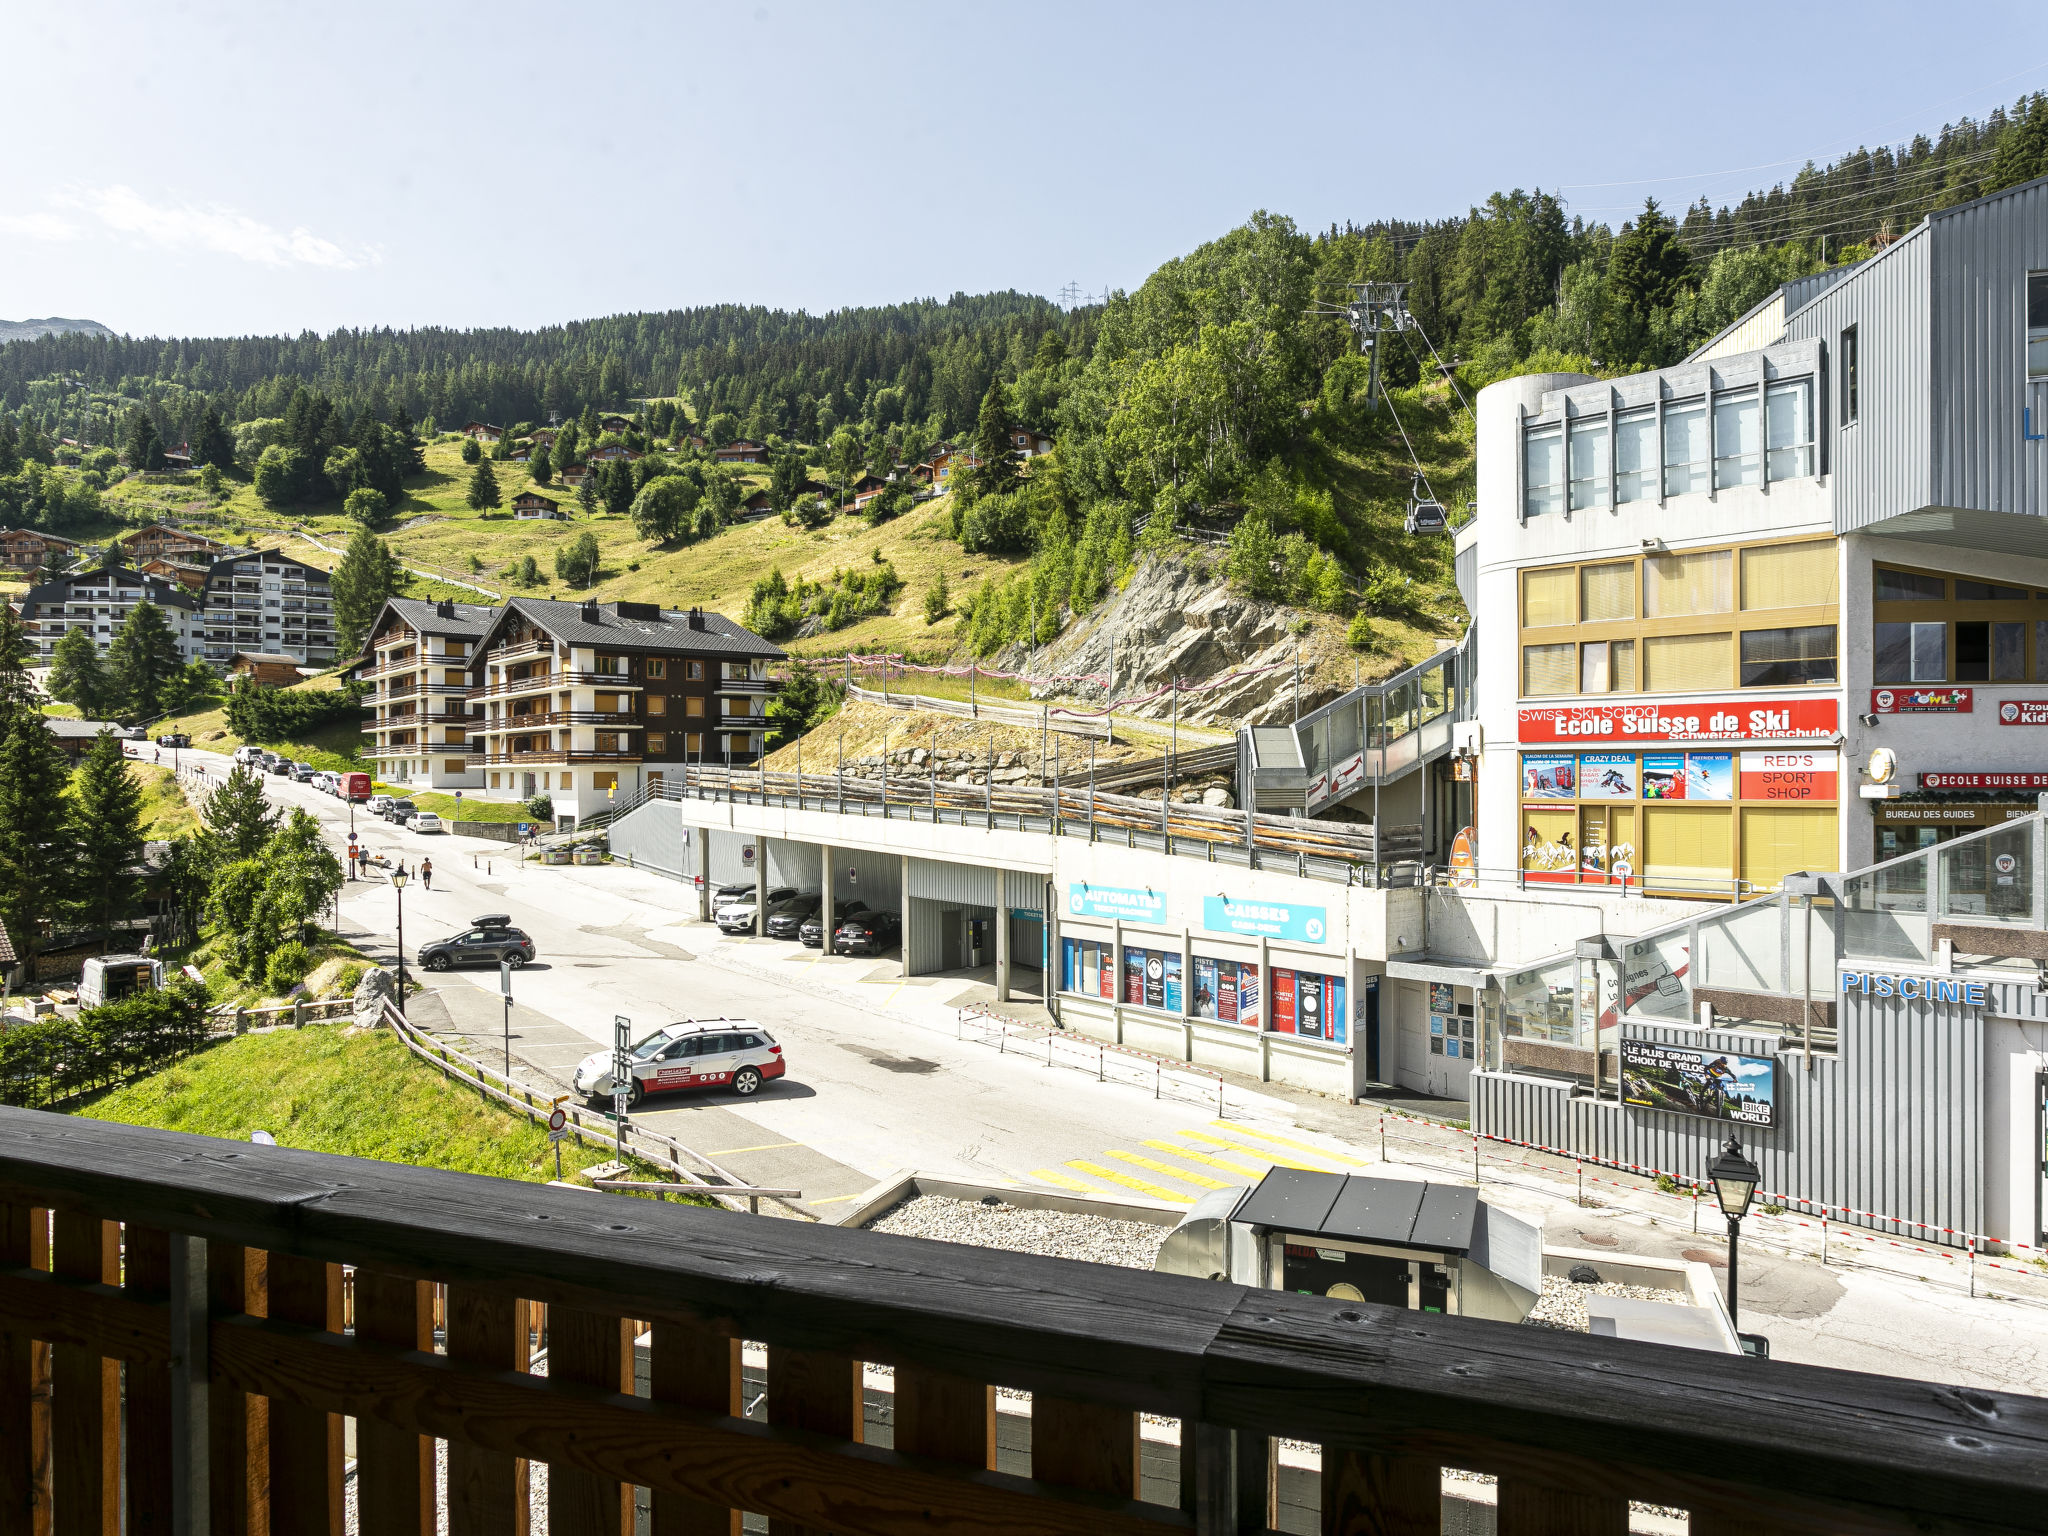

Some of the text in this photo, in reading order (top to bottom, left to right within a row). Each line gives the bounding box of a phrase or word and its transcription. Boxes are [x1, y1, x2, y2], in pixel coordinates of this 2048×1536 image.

[1519, 704, 1659, 722] Swiss Ski School
[2021, 712, 2048, 723] Kid
[1554, 709, 1790, 736] Ecole Suisse de Ski
[1668, 727, 1831, 740] Schweizer Skischule
[1584, 755, 1631, 763] CRAZY DEAL
[1764, 755, 1813, 767] RED'S
[1762, 772, 1816, 784] SPORT
[1941, 775, 2048, 785] ECOLE SUISSE DE
[1767, 787, 1812, 799] SHOP
[1885, 810, 1975, 819] BUREAU DES GUIDES
[1085, 889, 1162, 909] AUTOMATES
[1093, 903, 1118, 914] TICKET
[1223, 903, 1290, 922] CAISSES
[1231, 920, 1282, 933] CASH-DESK
[1194, 957, 1214, 966] PISTE
[1195, 969, 1213, 978] LUGE
[1607, 968, 1649, 988] Coignes
[1366, 976, 1378, 984] SES
[1607, 985, 1640, 1001] Loers
[1841, 972, 1986, 1006] PISCINE
[1627, 1046, 1701, 1063] LE PLUS GRAND
[1627, 1055, 1706, 1073] CHOIX DE VÉLOS
[1743, 1103, 1768, 1114] BIKE
[1729, 1109, 1771, 1124] WORLD
